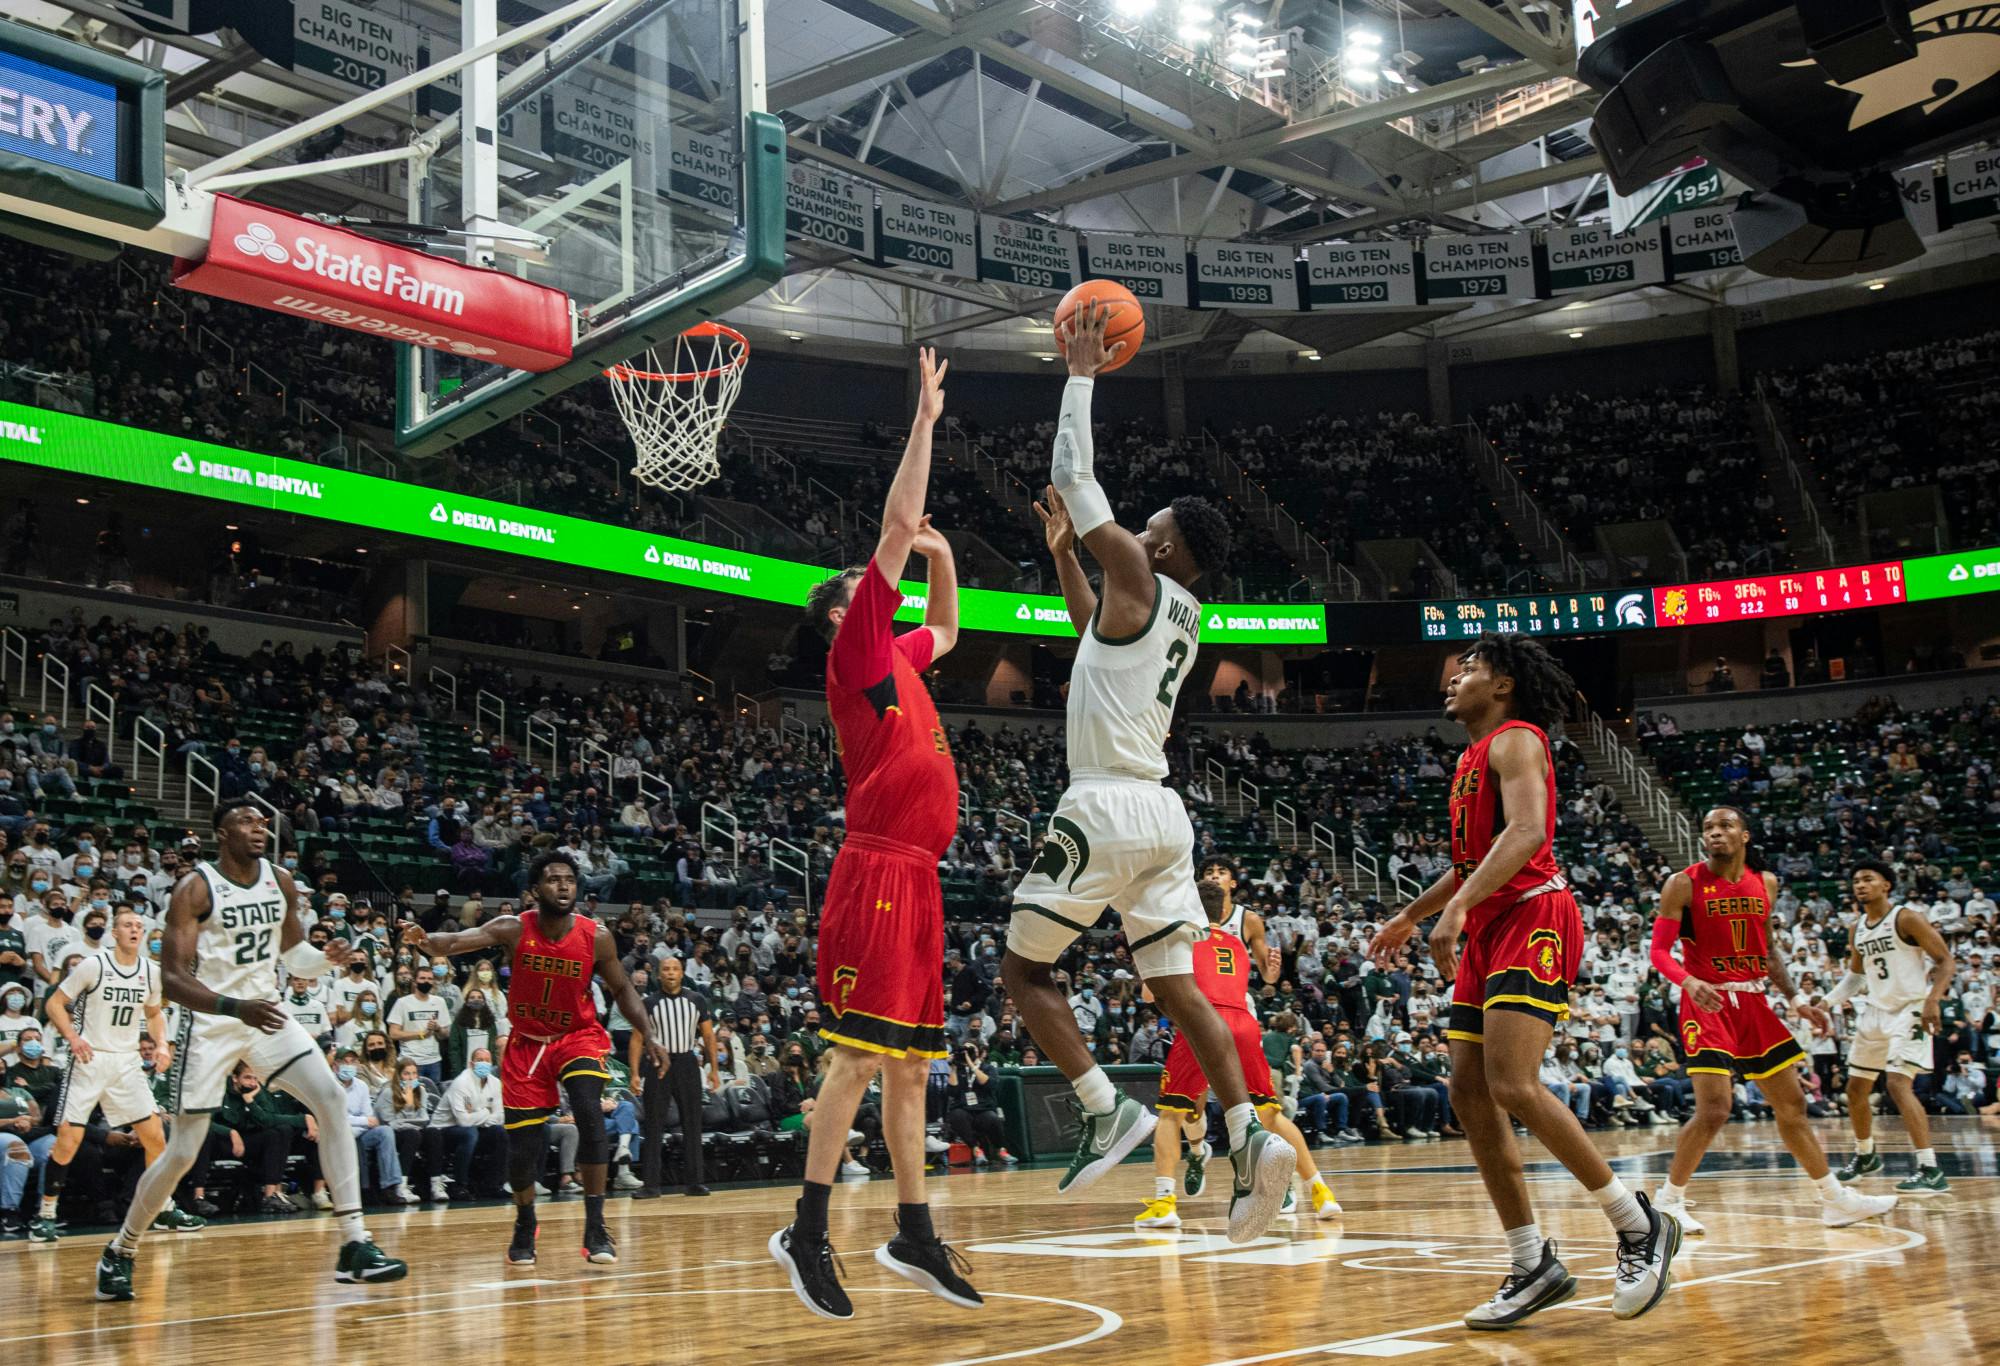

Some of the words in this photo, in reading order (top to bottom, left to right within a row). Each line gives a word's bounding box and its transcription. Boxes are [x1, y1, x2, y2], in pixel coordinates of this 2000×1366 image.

[321, 4, 353, 29] BIG
[357, 17, 393, 44] TEN
[298, 17, 415, 70] CHAMPIONS
[332, 57, 382, 90] 2012
[575, 98, 601, 120] BIG
[604, 109, 634, 131] TEN
[557, 111, 653, 155] CHAMPIONS
[689, 139, 714, 160] BIG
[671, 151, 733, 182] CHAMPI
[698, 182, 732, 205] 200
[786, 181, 864, 214] TOURNAMENT
[1673, 174, 1719, 205] 1957
[786, 194, 865, 229] CHAMPIONS
[902, 203, 926, 221] BIG
[928, 208, 956, 227] TEN
[1694, 213, 1724, 229] BIG
[800, 216, 849, 245] 2000
[885, 216, 974, 247] CHAMPIONS
[1570, 232, 1600, 246] BIG
[907, 244, 951, 266] 2000
[993, 234, 1068, 257] TOURNAMENT
[1107, 242, 1133, 256] BIG
[1136, 245, 1166, 258] TEN
[1217, 249, 1242, 262] BIG
[1246, 251, 1274, 264] TEN
[1329, 250, 1356, 263] BIG
[1361, 248, 1390, 261] TEN
[1446, 243, 1474, 257] BIG
[1477, 241, 1509, 254] TEN
[1551, 238, 1659, 265] CHAMPIONS
[993, 246, 1071, 271] CHAMPIONS
[1092, 256, 1185, 275] CHAMPIONS
[1429, 256, 1530, 273] CHAMPIONS
[1709, 250, 1742, 267] 196
[1010, 265, 1054, 287] 1999
[1200, 264, 1294, 280] CHAMPIONS
[1312, 263, 1411, 279] CHAMPIONS
[1584, 264, 1629, 282] 1978
[1228, 286, 1269, 301] 1998
[1341, 285, 1385, 300] 1990
[1459, 279, 1502, 294] 1979
[199, 460, 253, 486] DELTA
[255, 471, 323, 499] DENTAL
[452, 509, 497, 533] DELTA
[499, 517, 556, 544] DENTAL
[663, 551, 701, 573] DELTA
[702, 558, 751, 582] DENTAL
[1698, 587, 1722, 603] FG%
[1734, 583, 1767, 600] 3FG%
[1780, 579, 1803, 595] FT%
[1816, 575, 1826, 591] R
[1839, 572, 1848, 588] A
[1861, 569, 1871, 585] B
[1884, 566, 1901, 582] TO
[1424, 605, 1445, 622] FG%
[1457, 603, 1486, 620] 3FG%
[1497, 602, 1518, 618] FT%
[1529, 600, 1539, 616] R
[1550, 599, 1558, 615] A
[1570, 598, 1579, 613] B
[1590, 596, 1605, 612] TO
[1706, 604, 1719, 618] 30
[1740, 600, 1765, 615] 22.2
[1843, 590, 1851, 604] 4
[1865, 588, 1873, 602] 1
[1034, 607, 1072, 624] DELTA
[1226, 617, 1265, 631] DELTA
[1267, 617, 1320, 631] DENTAL
[1463, 622, 1482, 635] 33.3
[1529, 618, 1542, 632] 18
[1572, 616, 1580, 629] 2
[1596, 614, 1604, 627] 5
[1156, 638, 1189, 709] 2
[222, 900, 281, 930] STATE
[1706, 896, 1765, 918] FERRIS
[235, 928, 273, 966] 22
[1729, 919, 1748, 953] 11
[1856, 935, 1895, 957] STATE
[522, 952, 584, 979] FERRIS
[1211, 946, 1236, 976] 3
[1711, 955, 1769, 974] STATE
[1873, 956, 1889, 981] 3
[103, 986, 145, 1004] STATE
[541, 977, 553, 1005] 1
[110, 1005, 134, 1027] 10
[515, 1002, 574, 1028] STATE
